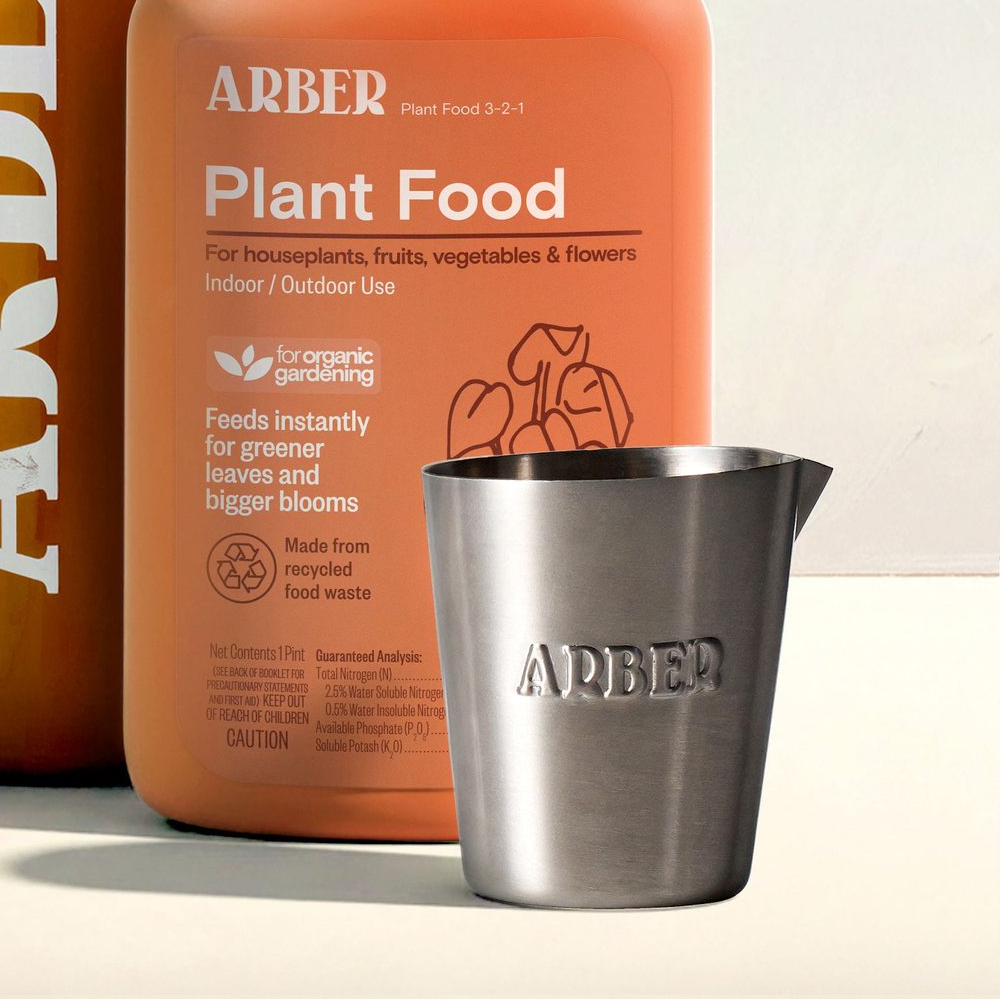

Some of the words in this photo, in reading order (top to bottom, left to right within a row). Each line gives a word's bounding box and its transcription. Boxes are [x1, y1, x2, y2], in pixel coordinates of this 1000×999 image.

[206, 65, 386, 115] ARBER
[401, 102, 437, 116] Plant
[442, 102, 480, 116] Food
[484, 102, 524, 115] 3-2-1
[205, 165, 373, 221] Plant
[400, 167, 565, 221] Food
[205, 244, 238, 262] For
[244, 245, 368, 268] houseplants,
[374, 247, 428, 267] fruits,
[433, 246, 541, 269] vegetables
[546, 246, 560, 263] &
[565, 244, 636, 263] flowers
[205, 273, 264, 293] Indoor
[268, 274, 276, 295] /
[281, 274, 356, 295] Outdoor
[361, 276, 395, 295] Use
[277, 345, 301, 363] for
[303, 347, 373, 368] organic
[275, 365, 374, 387] gardening
[206, 407, 269, 430] Feeds
[275, 410, 369, 436] instantly
[205, 435, 235, 456] for
[241, 441, 324, 462] greener
[206, 462, 273, 484] leaves
[279, 464, 319, 485] and
[206, 489, 273, 516] bigger
[279, 491, 359, 512] blooms
[285, 537, 328, 553] Made
[332, 538, 370, 553] from
[285, 561, 352, 579] recycled
[285, 584, 319, 599] food
[324, 586, 371, 600] waste
[210, 643, 228, 659] Net
[230, 644, 276, 661] Contents
[279, 646, 282, 661] 1
[285, 646, 305, 662] Pint
[316, 649, 374, 662] Guaranteed
[377, 650, 422, 665] Analysis:
[213, 666, 229, 677] (SEE
[229, 667, 249, 678] BACK
[250, 668, 258, 678] OF
[259, 669, 290, 679] BOOKLET
[291, 669, 304, 679] FOR
[316, 667, 338, 680] Total
[340, 667, 377, 684] Nitrogen
[379, 667, 392, 681] (N)
[516, 637, 724, 699] ARBER
[207, 681, 263, 692] PRECAUTIONARY
[264, 682, 308, 694] STATEMENTS
[325, 684, 347, 698] 2.5%
[349, 685, 374, 698] Water
[376, 685, 407, 699] Soluble
[224, 695, 243, 706] FIRST
[244, 696, 259, 707] AID)
[263, 694, 286, 708] KEEP
[287, 695, 306, 708] OUT
[325, 702, 347, 716] 0.5%
[349, 703, 374, 716] Water
[377, 703, 415, 717] Insoluble
[206, 708, 217, 721] OF
[219, 708, 249, 723] REACH
[251, 709, 262, 723] OF
[264, 710, 309, 725] CHILDREN
[315, 721, 354, 734] Available
[357, 722, 402, 737] Phosphate
[226, 728, 288, 749] CAUTION
[315, 738, 347, 751] Soluble
[349, 739, 379, 753] Potash
